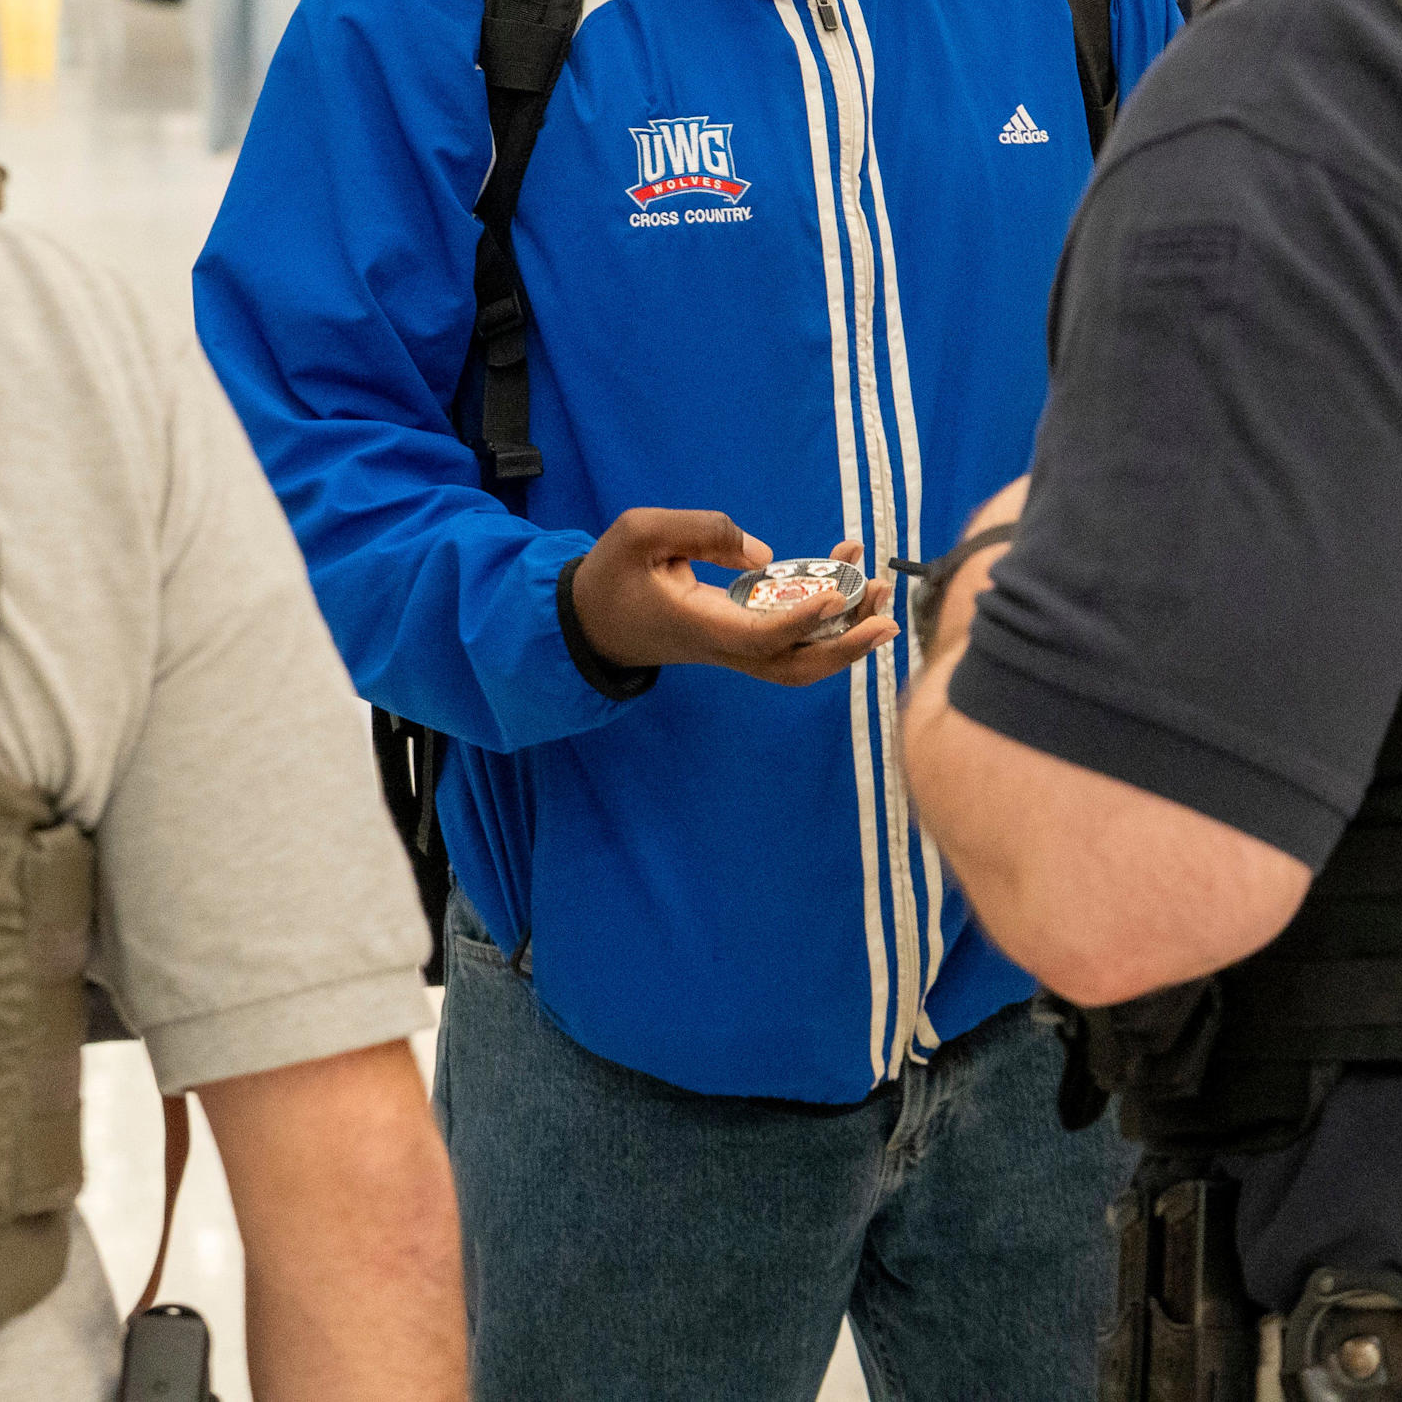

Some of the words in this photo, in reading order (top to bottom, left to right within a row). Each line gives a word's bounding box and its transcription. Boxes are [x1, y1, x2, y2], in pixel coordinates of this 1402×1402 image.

[999, 130, 1049, 144] adidas
[638, 122, 730, 182] UWG
[652, 176, 723, 194] WOLVES
[629, 211, 679, 227] CROSS
[684, 206, 753, 224] COUNTRY
